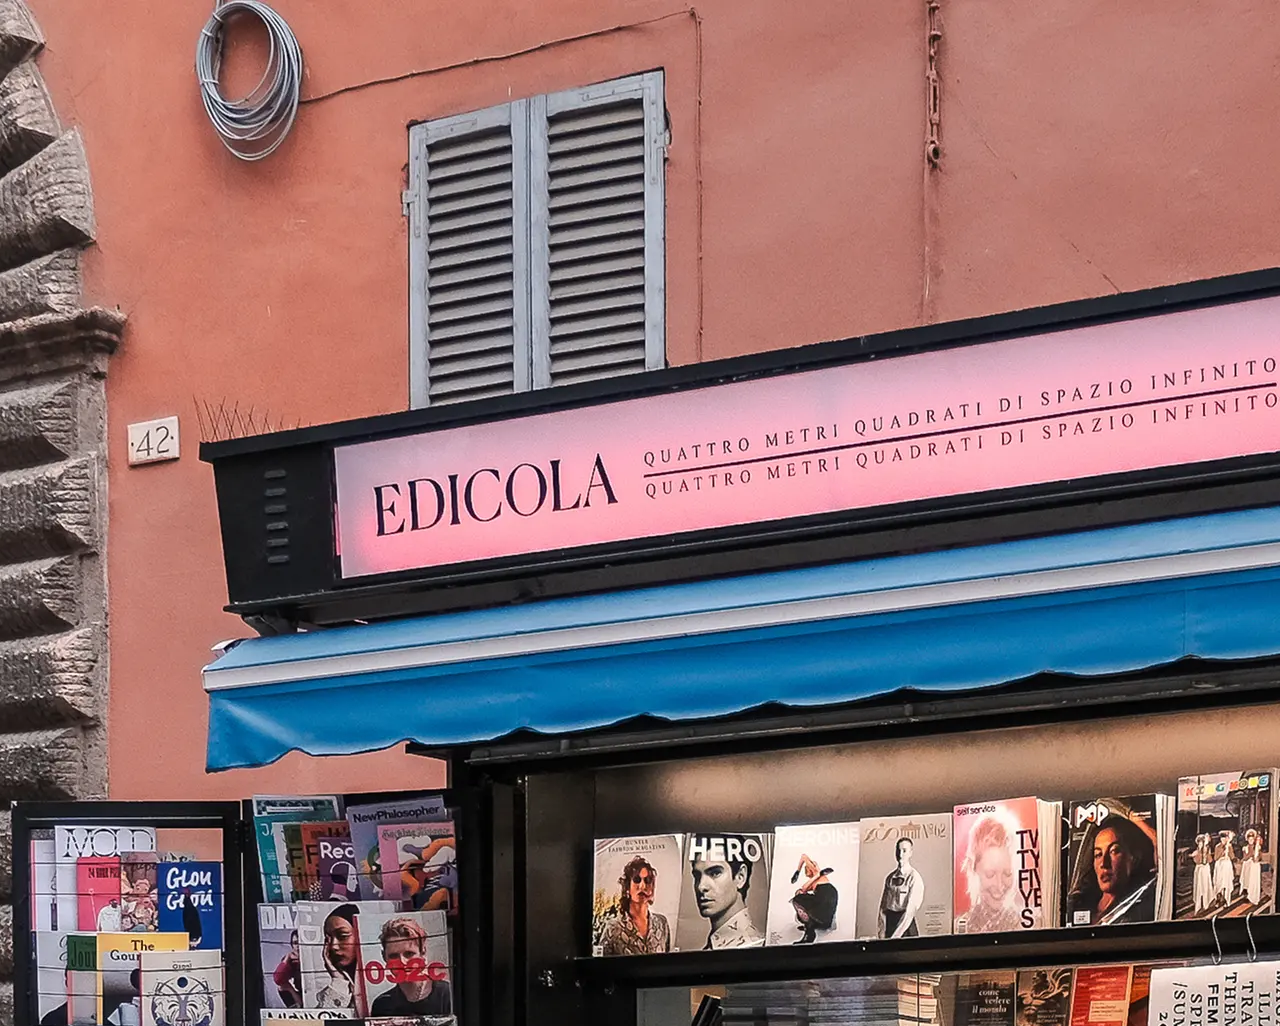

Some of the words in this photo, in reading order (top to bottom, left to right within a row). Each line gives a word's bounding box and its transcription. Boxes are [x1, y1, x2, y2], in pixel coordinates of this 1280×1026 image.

[644, 437, 750, 468] QUATTRO
[765, 424, 838, 447] METRI
[855, 402, 982, 437] QUADRATI
[1000, 396, 1022, 413] DI
[1041, 380, 1132, 406] SPAZIO
[1151, 358, 1276, 390] INFINITO
[136, 426, 169, 456] 42
[645, 470, 751, 500] QUATTRO
[766, 457, 839, 480] METRI
[856, 436, 983, 469] QUADRATI
[1001, 430, 1024, 446] DI
[1042, 413, 1134, 440] SPAZIO
[1153, 393, 1278, 424] INFINITO
[374, 454, 618, 537] EDICOLA
[1185, 783, 1225, 797] KING
[1229, 775, 1270, 791] KONG
[353, 805, 440, 824] NewPhilosopher
[689, 837, 763, 863] HERO
[131, 940, 155, 951] The
[365, 956, 447, 984] 032c
